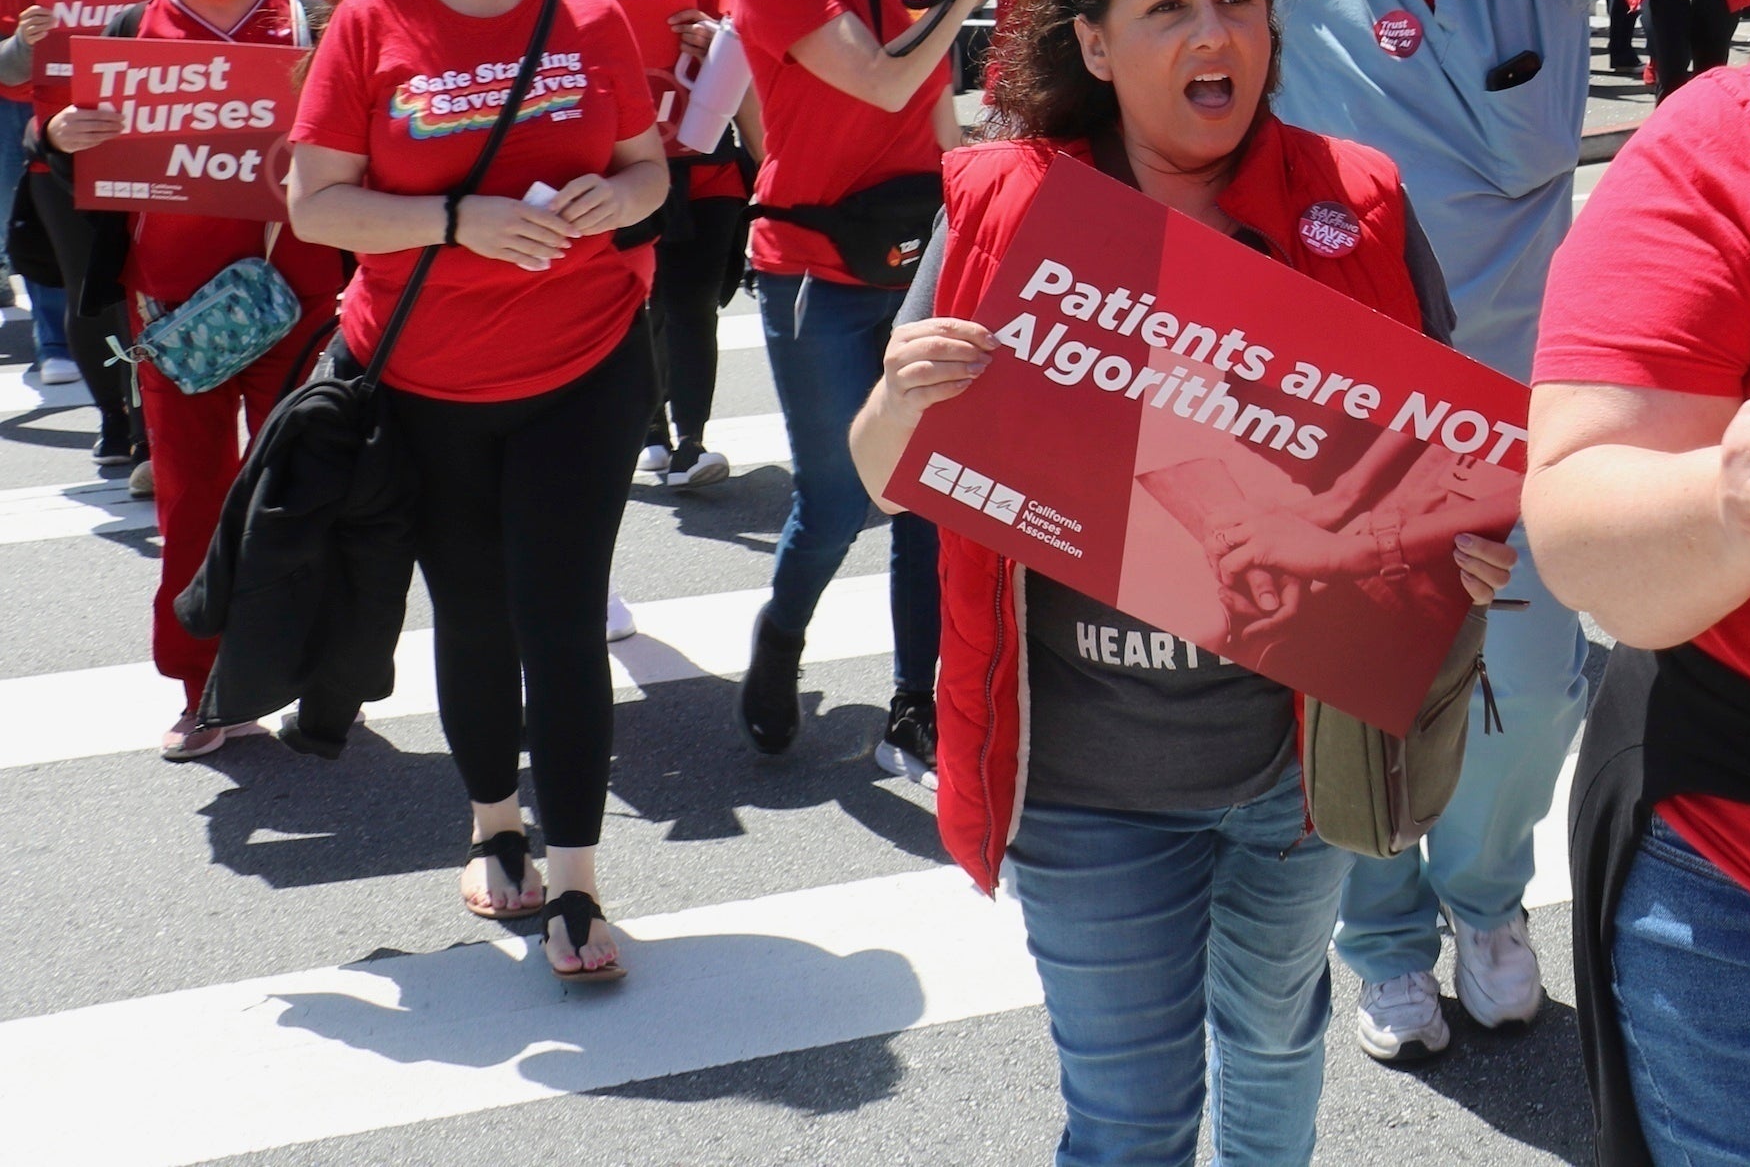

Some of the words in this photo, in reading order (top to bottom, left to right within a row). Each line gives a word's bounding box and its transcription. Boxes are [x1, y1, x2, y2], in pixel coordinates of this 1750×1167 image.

[1379, 28, 1416, 37] Nurses
[1381, 19, 1408, 29] Trust
[1400, 39, 1412, 48] AI
[92, 56, 231, 98] Trust
[409, 71, 472, 93] Safe
[475, 52, 582, 83] Staing
[430, 89, 511, 114] Saves
[165, 144, 261, 182] Not
[1310, 205, 1347, 220] SAFE
[1310, 213, 1359, 233] STAFFING
[1301, 225, 1340, 249] LIVES
[1312, 220, 1355, 247] SAVES
[1018, 259, 1277, 383] Patients
[1280, 358, 1382, 421] are
[1388, 391, 1529, 468] NOT
[991, 312, 1329, 461] Algorithms
[1022, 510, 1062, 536] Nurses
[1028, 500, 1082, 533] California
[1017, 521, 1083, 559] Association
[1076, 621, 1199, 670] HEART
